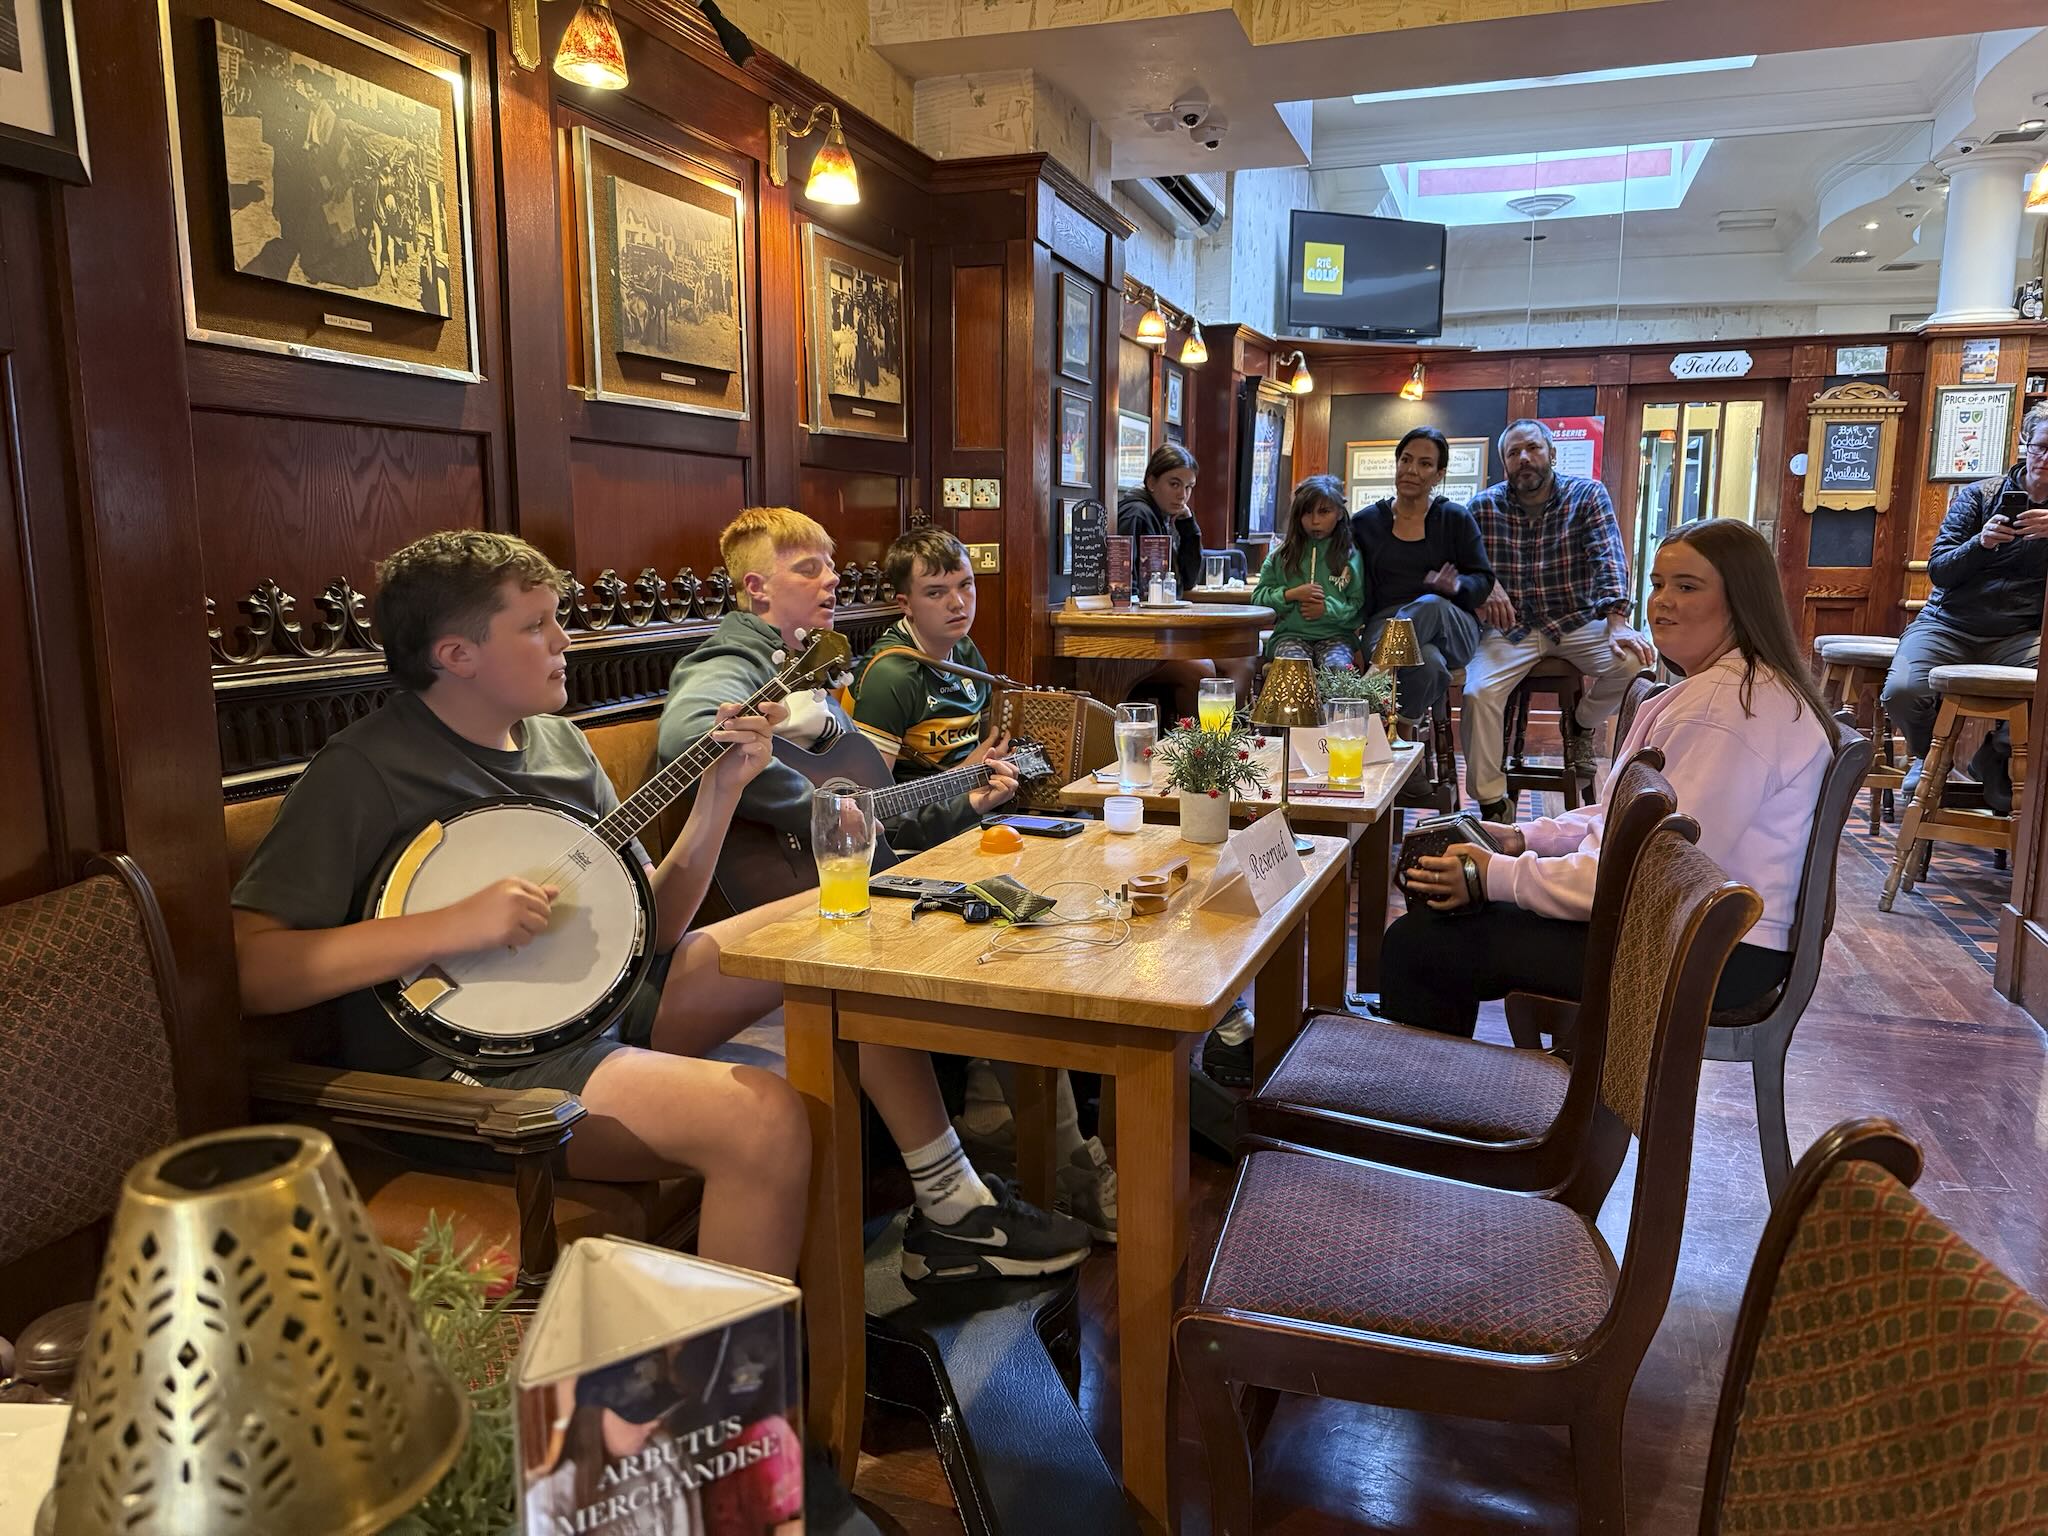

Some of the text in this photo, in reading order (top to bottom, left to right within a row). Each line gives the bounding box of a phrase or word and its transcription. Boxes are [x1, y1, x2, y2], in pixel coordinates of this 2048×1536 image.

[1682, 355, 1739, 375] Toilets
[1944, 394, 1966, 405] PRICE
[1987, 393, 2006, 405] PINT
[1561, 429, 1588, 437] SERIES
[1831, 435, 1869, 447] Cocktail
[1832, 448, 1860, 461] Menu
[1824, 464, 1871, 481] Available
[1249, 829, 1288, 880] Reserved
[597, 1415, 743, 1490] ARBUTUS
[554, 1433, 781, 1536] MERCHANDISE
